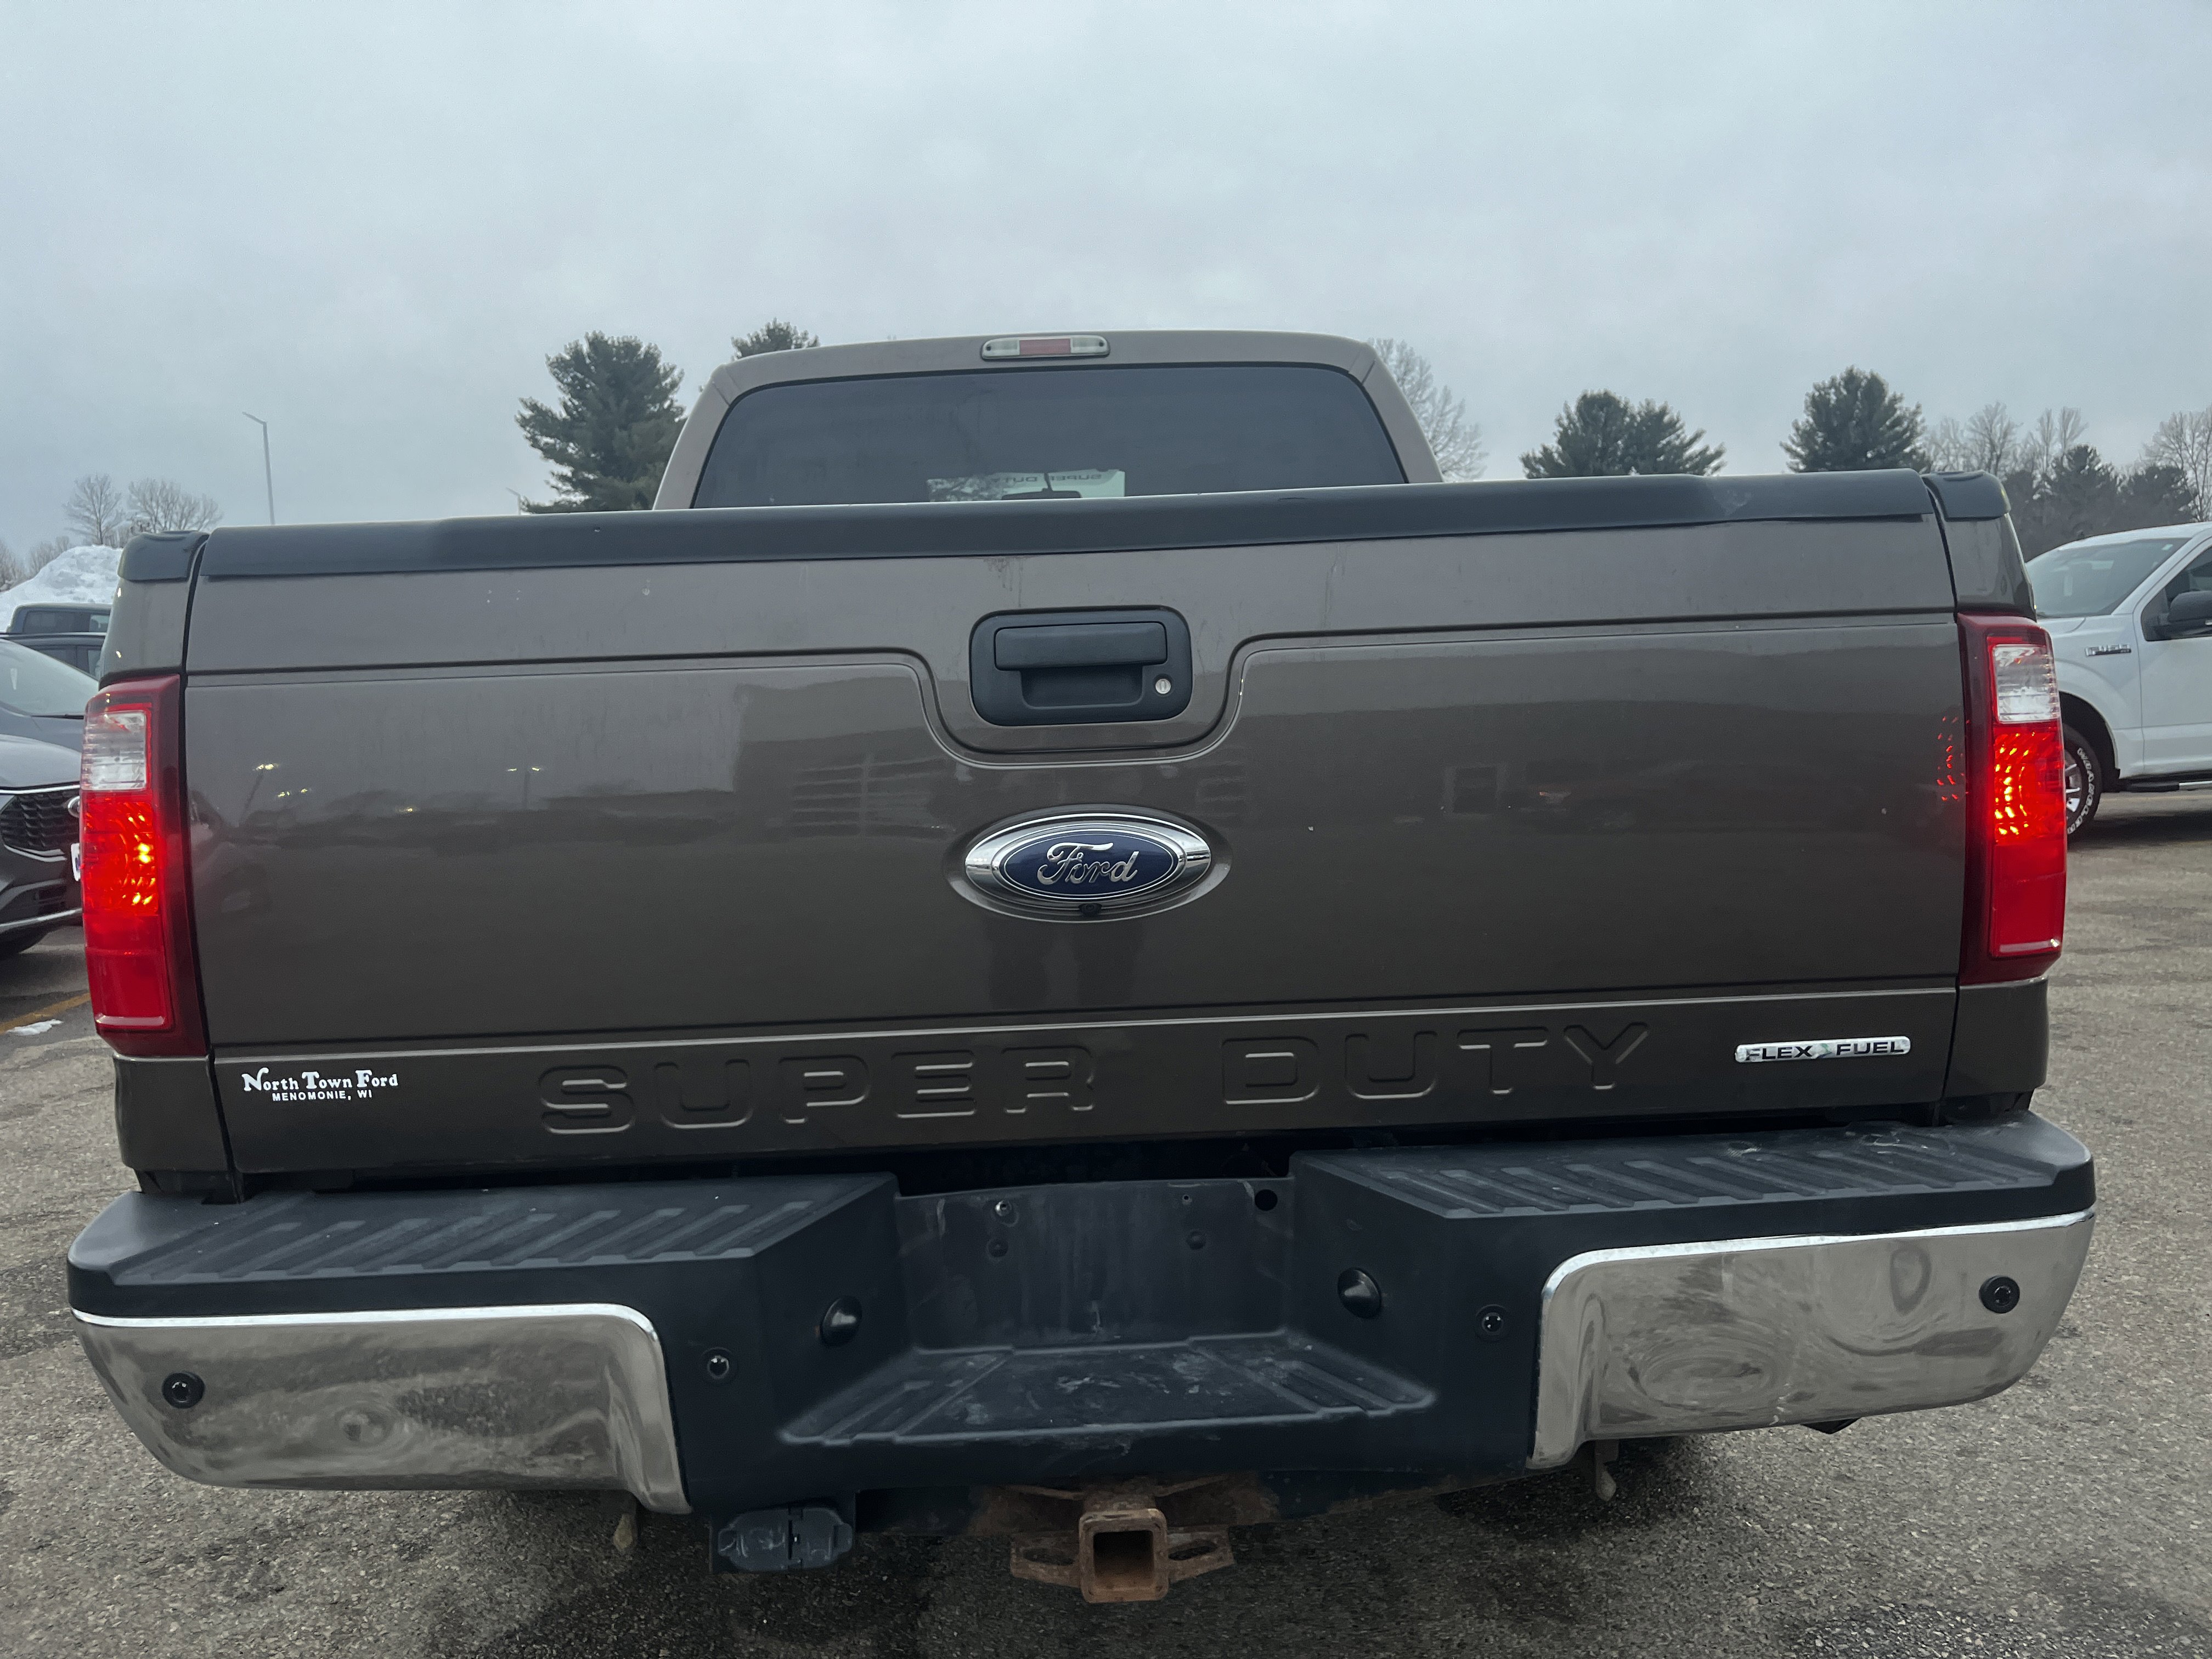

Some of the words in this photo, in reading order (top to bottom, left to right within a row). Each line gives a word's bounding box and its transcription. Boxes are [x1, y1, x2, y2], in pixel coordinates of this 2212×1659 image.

[1037, 842, 1138, 885] Ford
[1745, 1045, 1813, 1061] FLEX
[1836, 1041, 1905, 1057] FUEL
[241, 1067, 300, 1092] North
[301, 1071, 353, 1090] Town
[355, 1069, 399, 1088] Ford
[537, 1044, 1094, 1134] SUPER
[1221, 1022, 1650, 1105] DUTY
[272, 1090, 352, 1102] MENOMONIE,
[357, 1089, 373, 1099] WI
